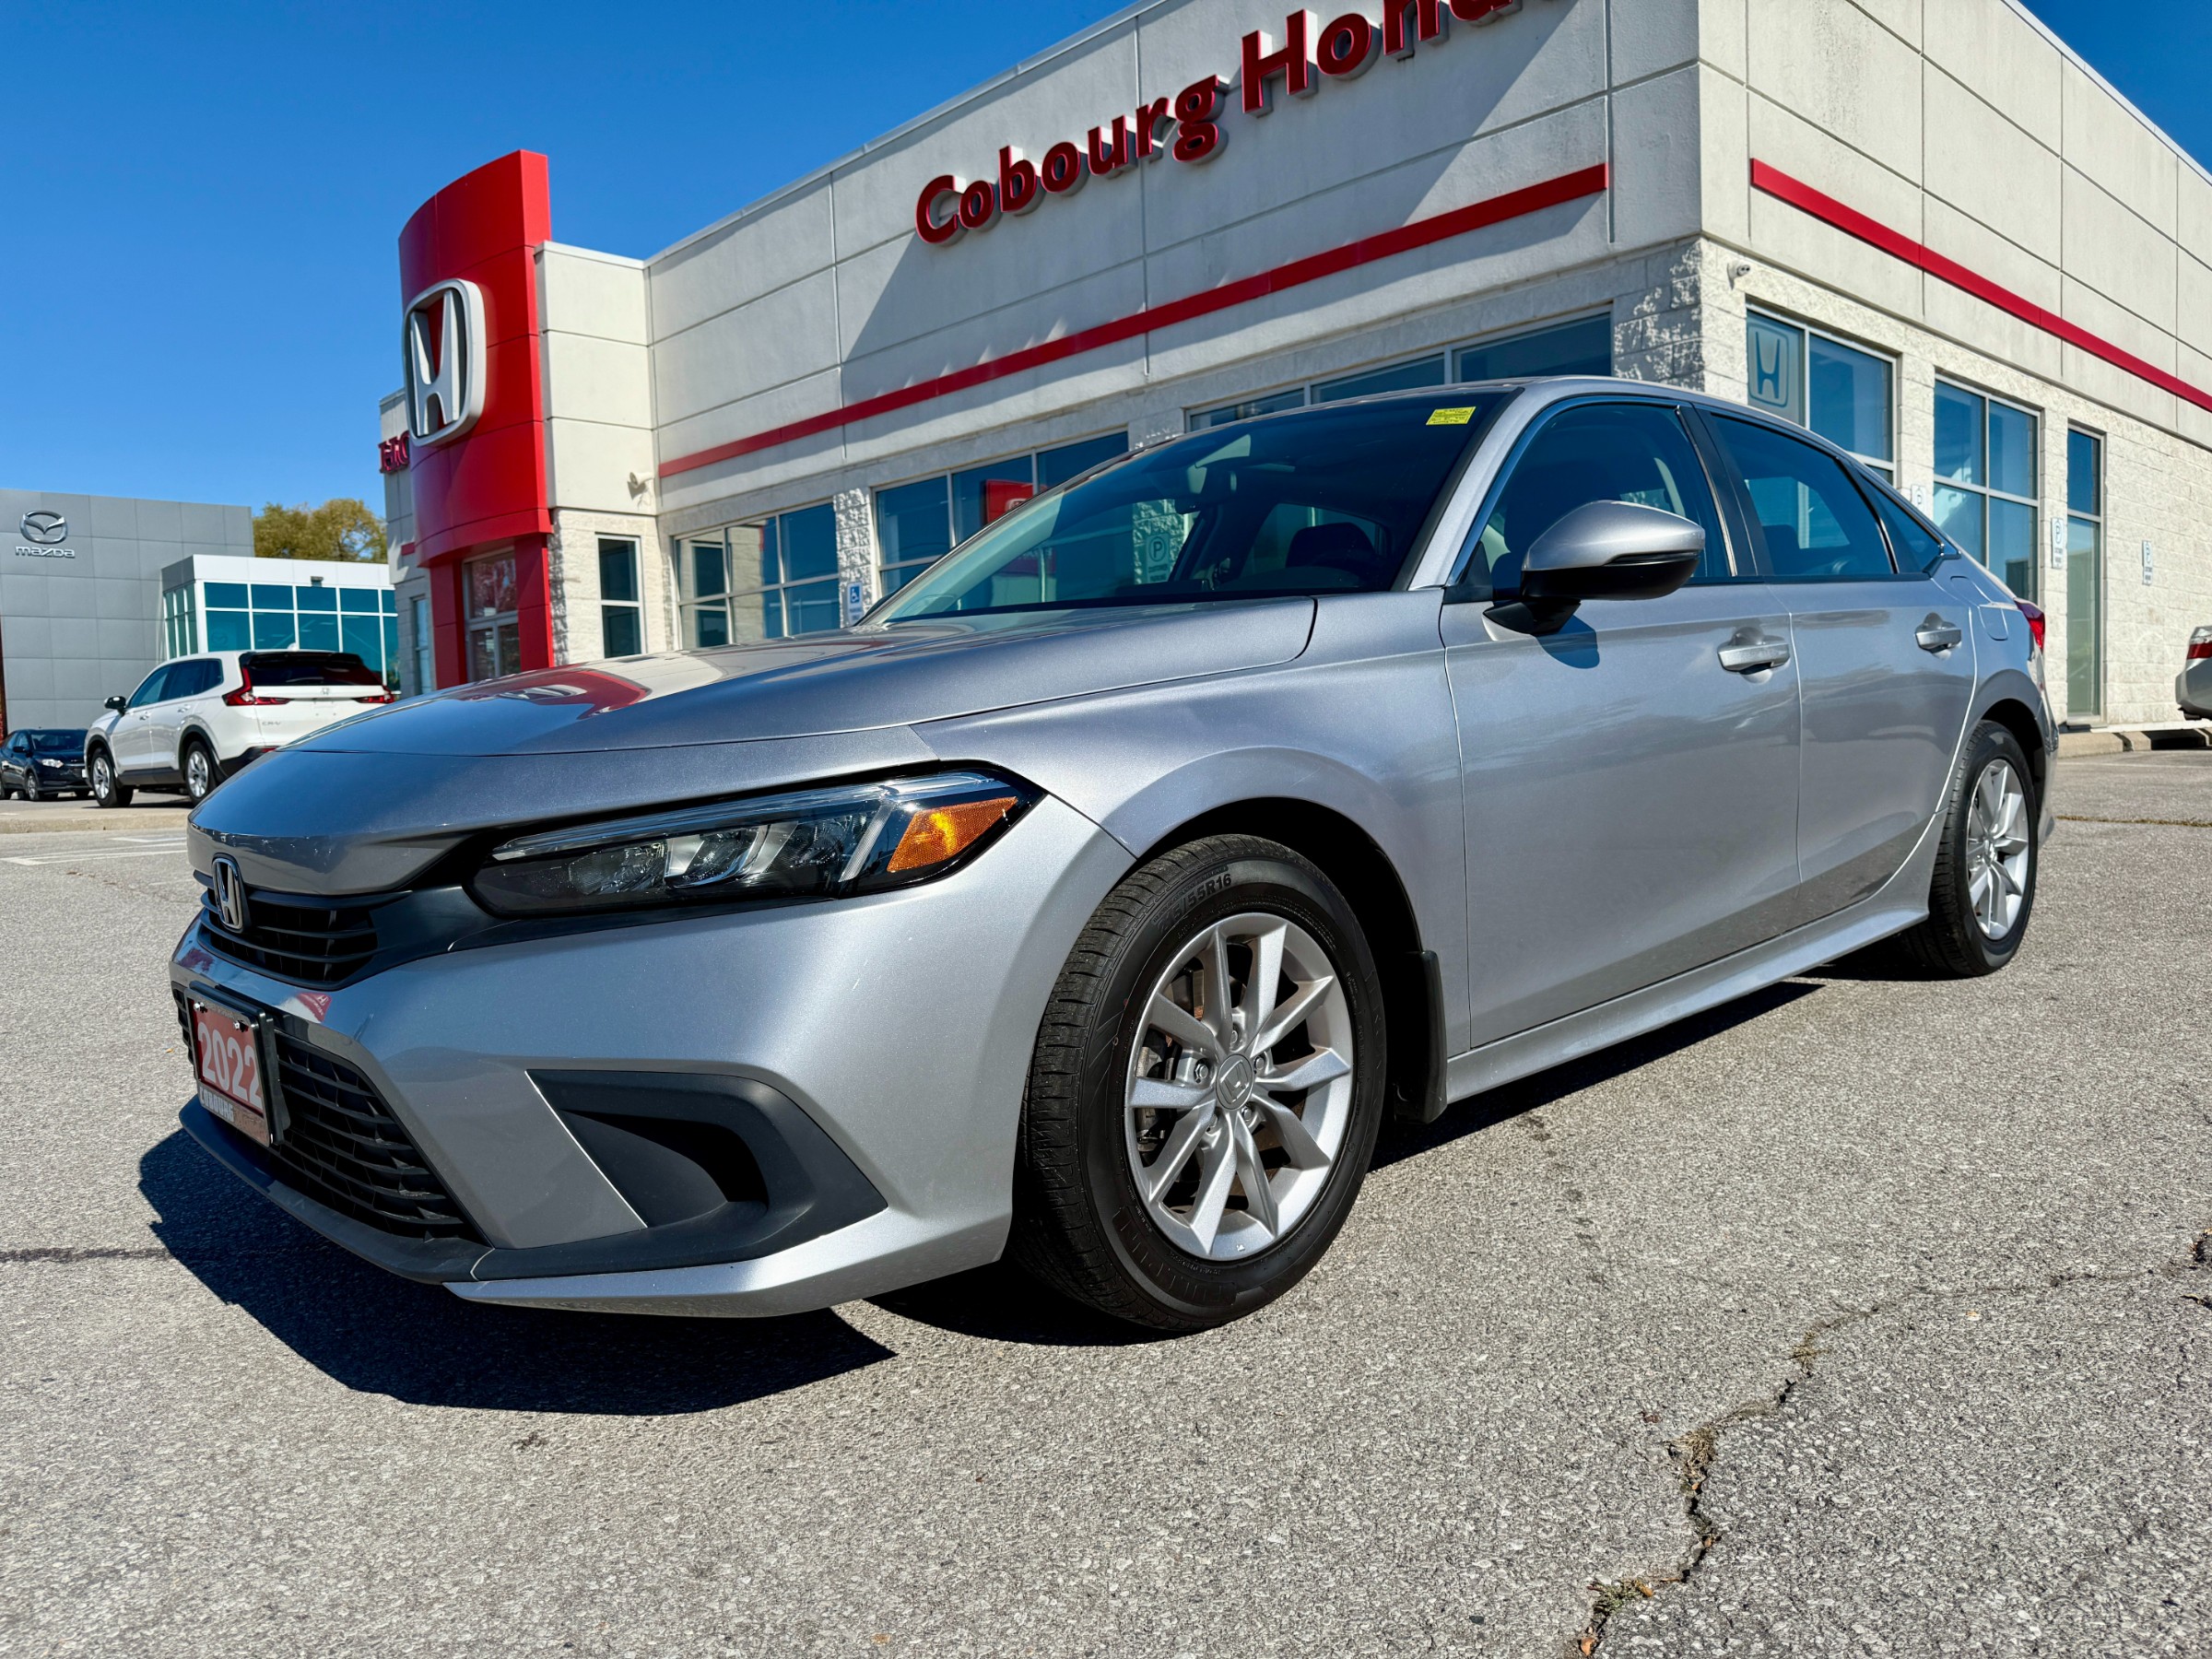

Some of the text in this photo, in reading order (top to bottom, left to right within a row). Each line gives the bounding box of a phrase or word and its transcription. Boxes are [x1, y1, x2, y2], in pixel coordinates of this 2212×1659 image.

[915, 0, 1516, 244] Cobourg Hon
[15, 546, 76, 559] mazda
[197, 1021, 264, 1111] 2022
